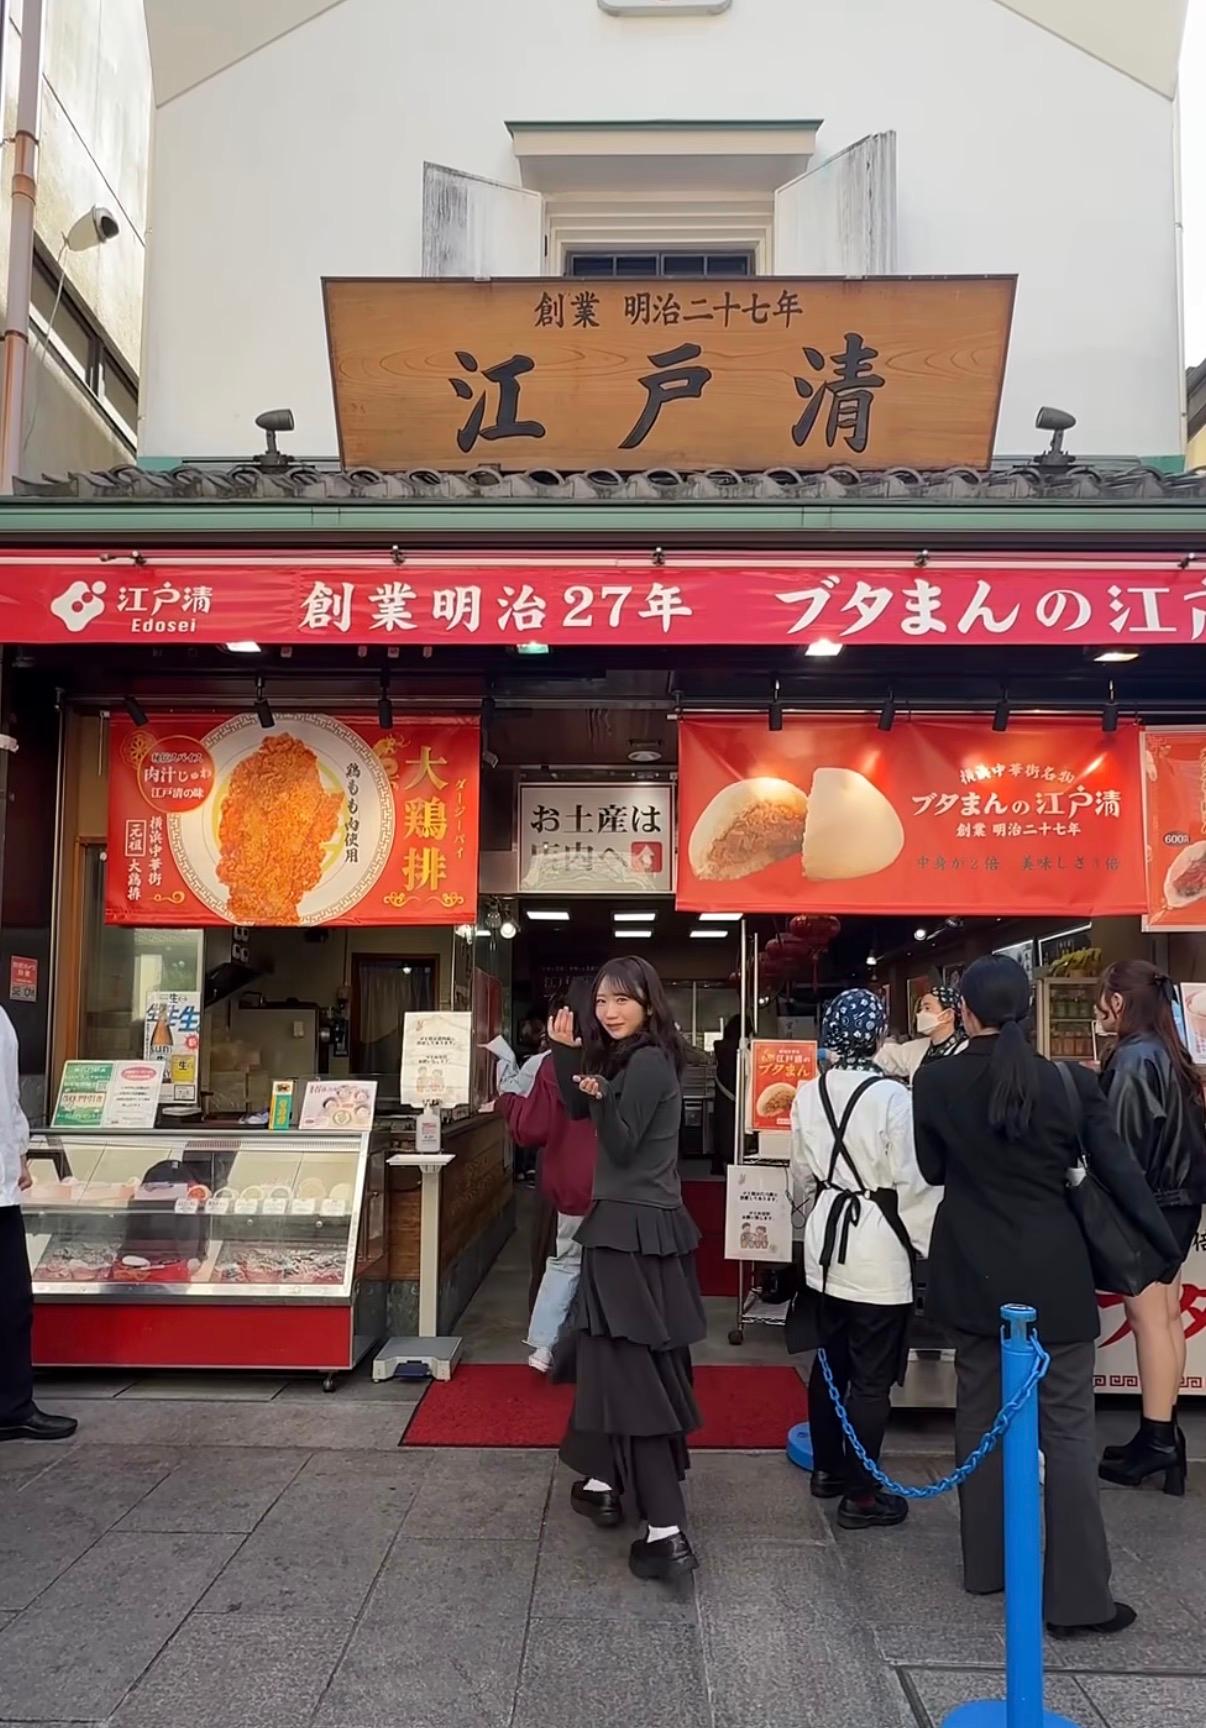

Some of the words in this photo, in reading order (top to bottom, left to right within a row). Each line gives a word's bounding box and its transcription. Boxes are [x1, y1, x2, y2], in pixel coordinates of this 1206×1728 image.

[534, 291, 600, 328] 創業
[623, 290, 804, 328] 明治二十七年
[448, 332, 886, 454] 江戸清
[117, 582, 213, 616] 江戸清
[297, 580, 694, 633] 創業明治27年
[130, 618, 197, 633] Edosei
[401, 745, 450, 893] 大鶏排
[530, 804, 662, 833] お土産は
[911, 785, 1122, 819] ブタまんの江戸清
[956, 822, 987, 838] 創業
[992, 821, 1082, 838] 明治二十七年
